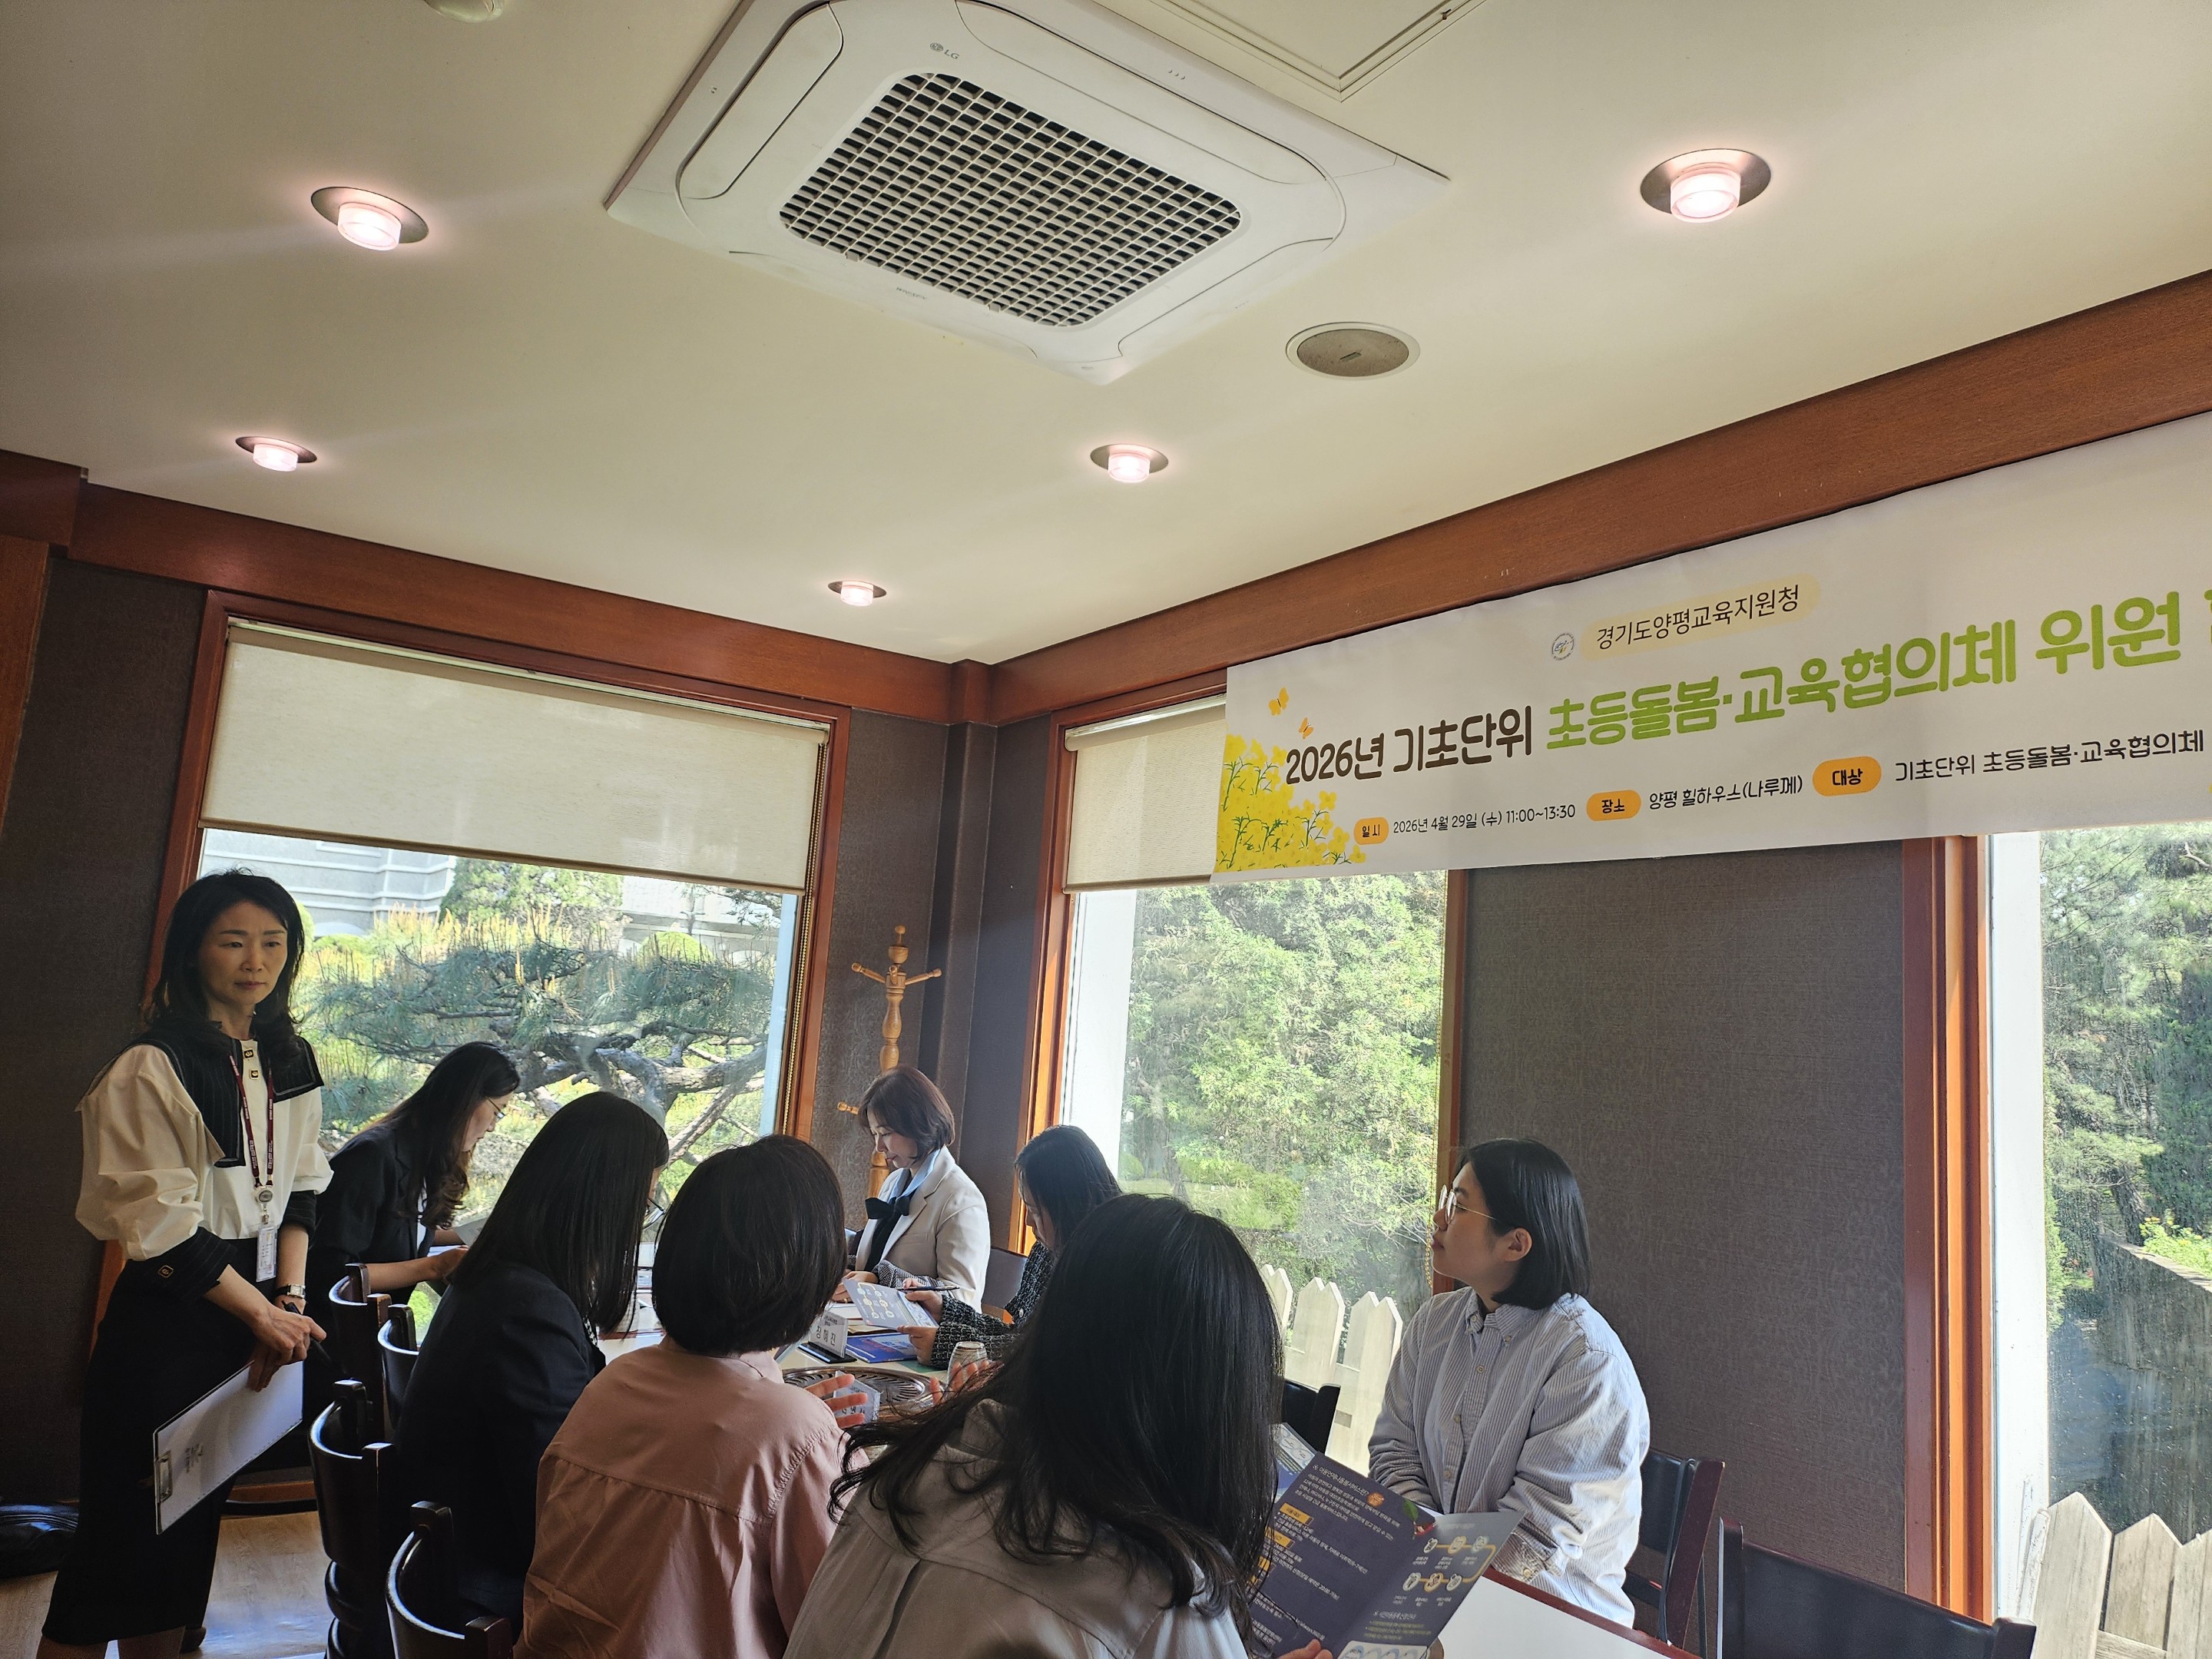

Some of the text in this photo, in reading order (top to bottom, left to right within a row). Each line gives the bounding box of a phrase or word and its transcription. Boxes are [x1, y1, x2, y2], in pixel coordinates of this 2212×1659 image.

[1597, 584, 1800, 650] 경기도양평교육지원청
[1286, 732, 1385, 785] 2026년
[1393, 705, 1532, 773] 기초단위
[1546, 619, 2016, 750] 초등돌봄·교육협의체
[2035, 591, 2181, 674] 위원
[1895, 729, 2204, 781] 기초단위 초등돌봄·교육협의체
[1832, 767, 1863, 786] 대상
[1601, 798, 1625, 814] 장소
[1649, 790, 1678, 810] 양평
[1393, 804, 1576, 834] 2026년 4월 29일 (수) 11:00~13:30
